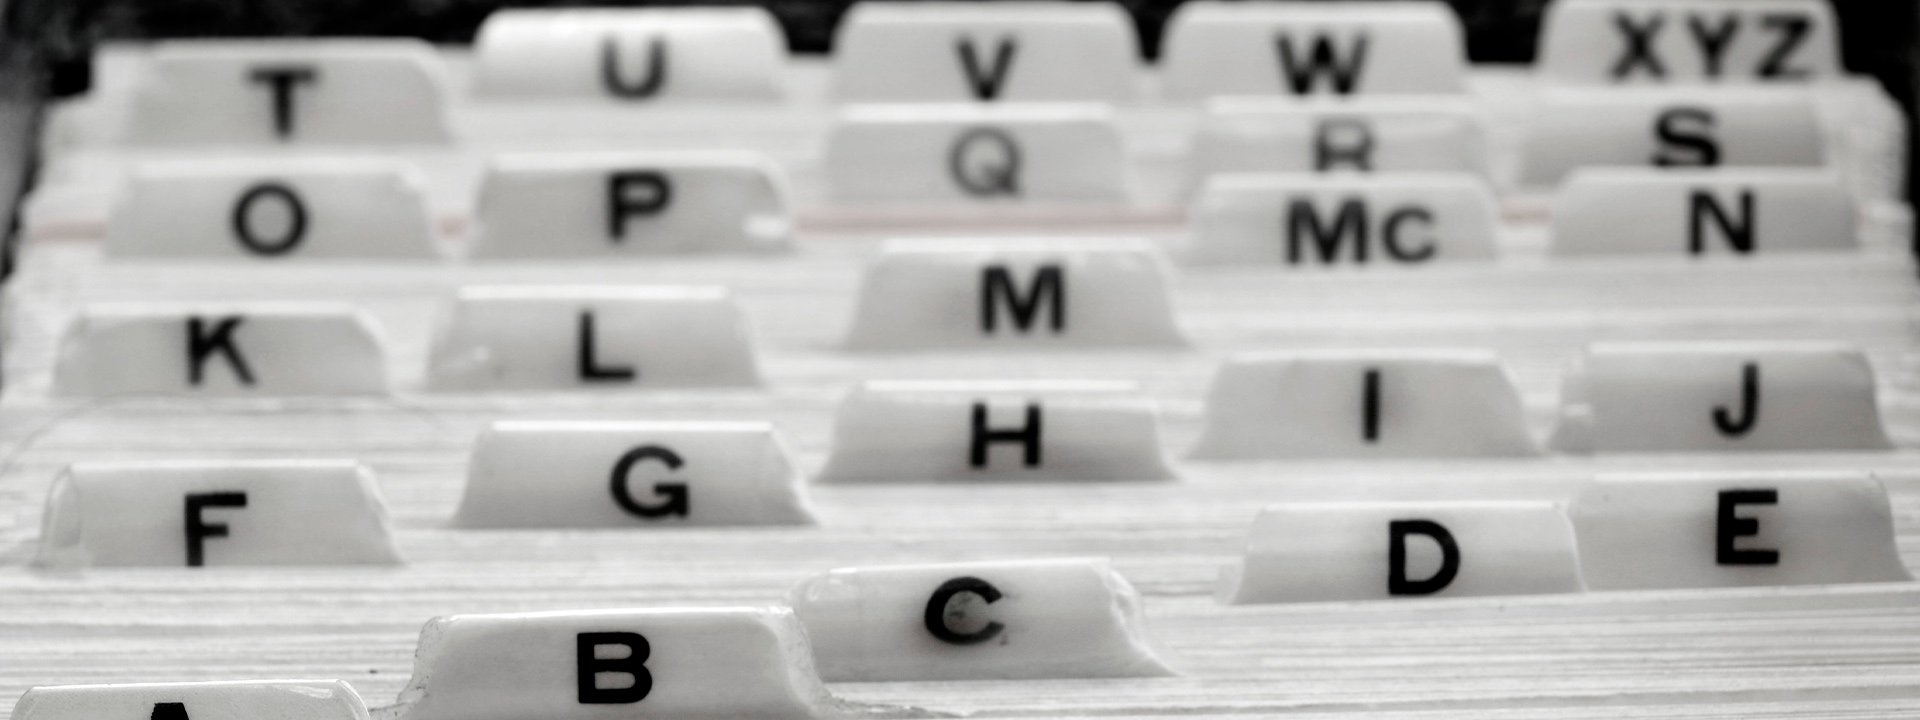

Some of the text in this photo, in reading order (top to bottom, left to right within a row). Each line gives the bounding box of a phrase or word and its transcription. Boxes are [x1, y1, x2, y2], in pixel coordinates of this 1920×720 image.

[602, 38, 667, 99] U
[957, 37, 1017, 100] V
[1278, 35, 1366, 95] W
[1612, 14, 1815, 81] XYZ
[250, 67, 316, 137] T
[947, 126, 1023, 197] Q
[1652, 107, 1723, 168] S
[231, 184, 308, 256] O
[607, 171, 672, 241] P
[1286, 198, 1436, 265] Mc
[1689, 191, 1757, 255] N
[980, 267, 1066, 334] M
[186, 317, 254, 385] K
[577, 313, 638, 383] L
[968, 404, 1043, 470] H
[1362, 370, 1382, 442] I
[1711, 364, 1759, 440] J
[610, 447, 691, 521] G
[184, 491, 247, 567] F
[1387, 520, 1460, 597] D
[1715, 490, 1780, 566] E
[924, 576, 1005, 646] C
[577, 632, 652, 704] B
